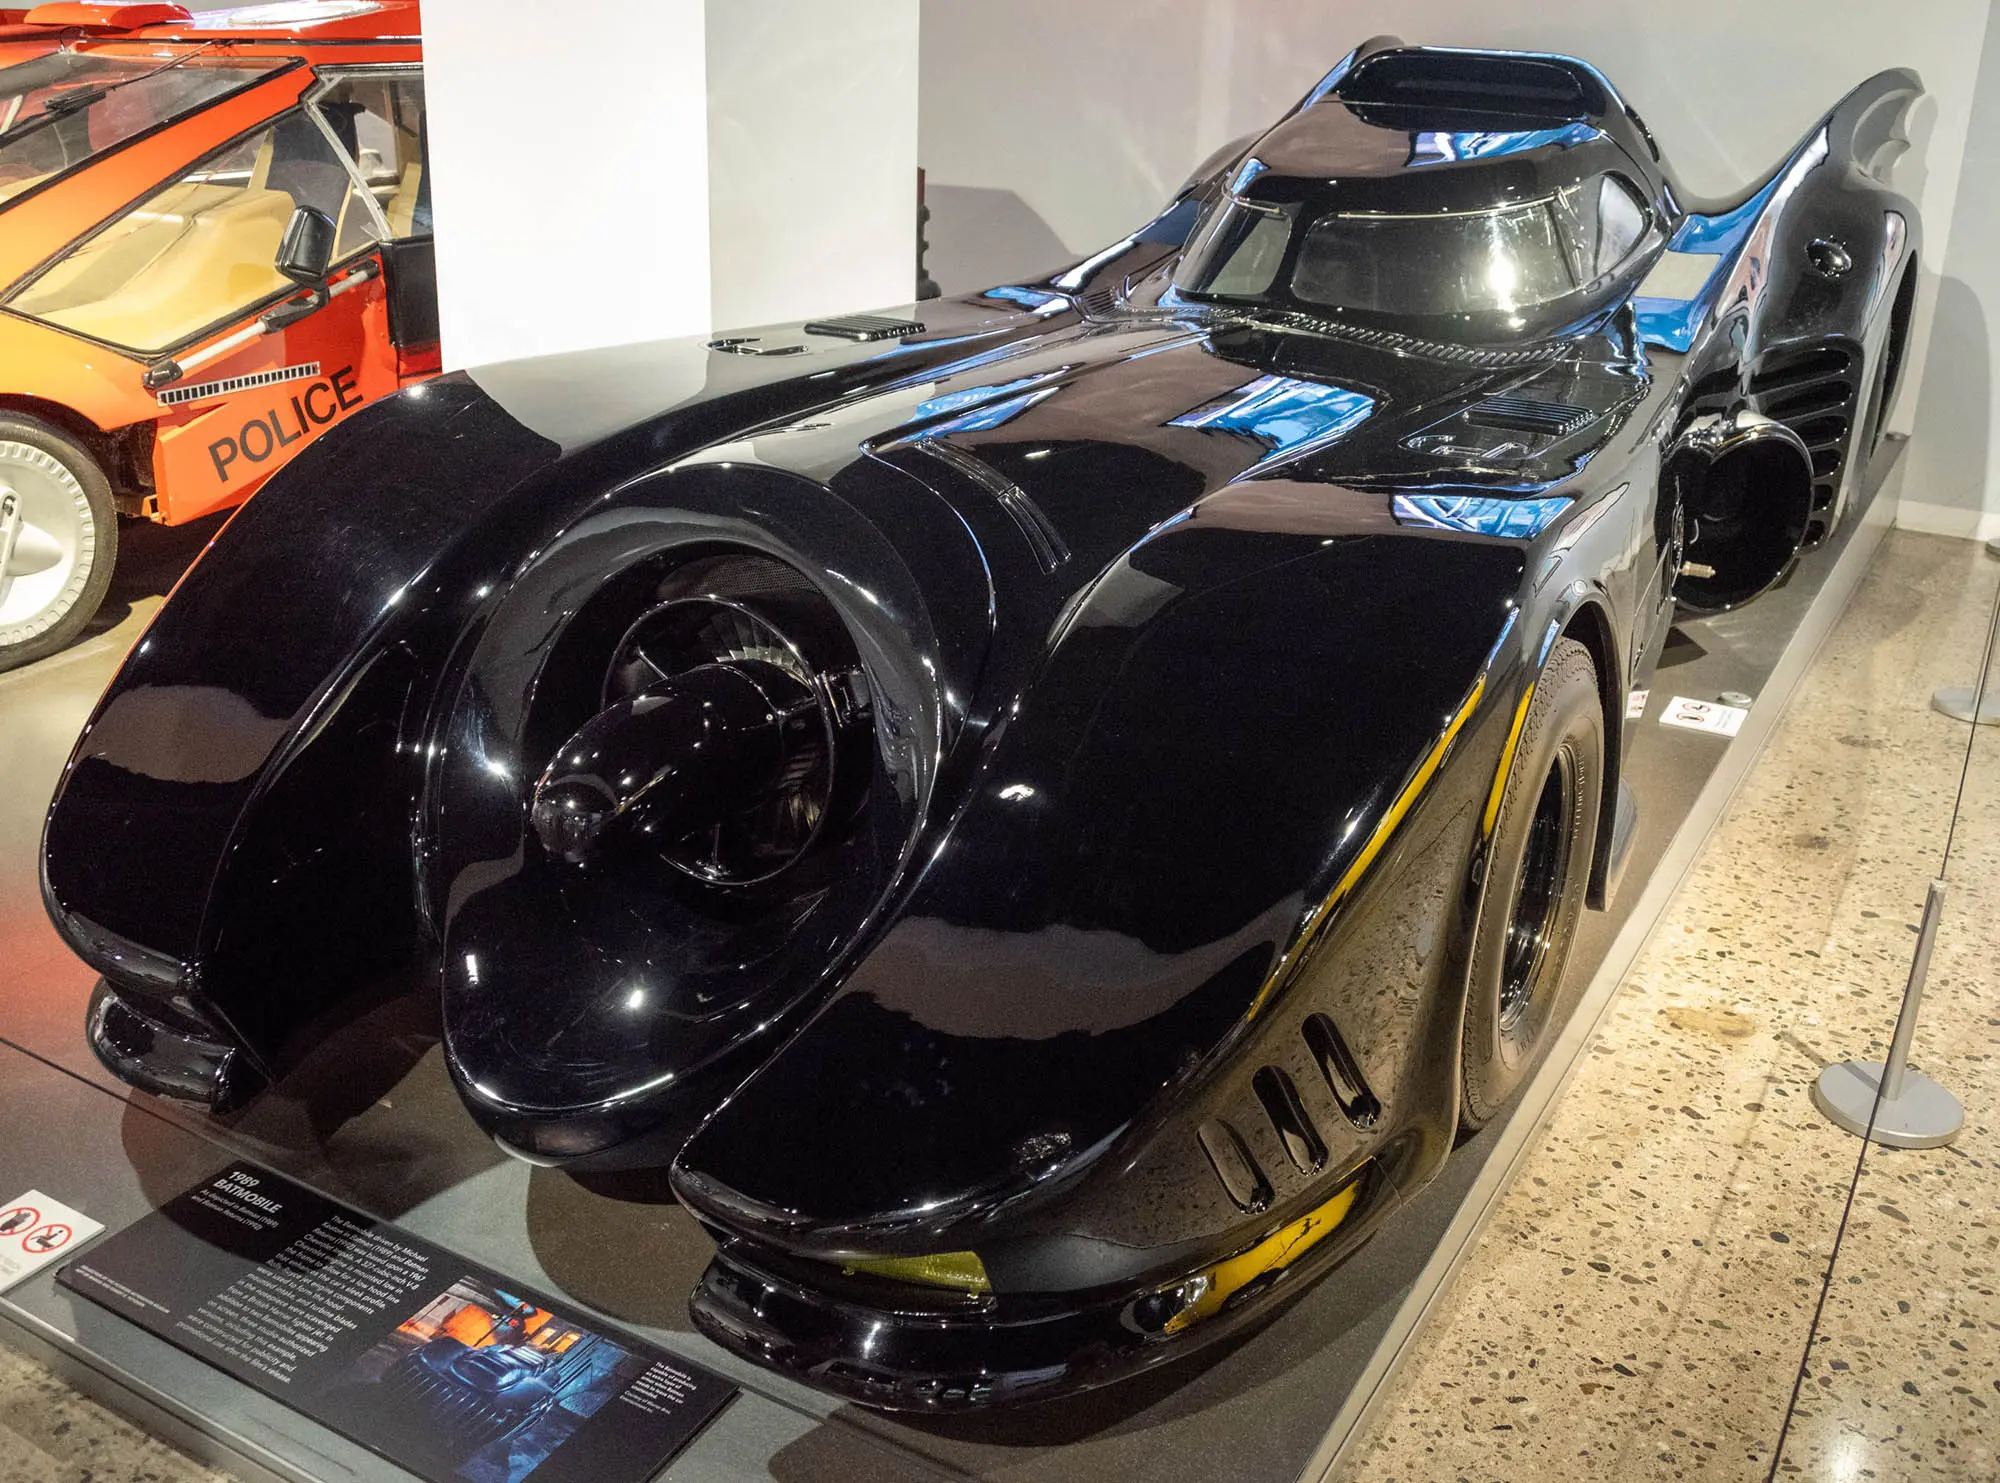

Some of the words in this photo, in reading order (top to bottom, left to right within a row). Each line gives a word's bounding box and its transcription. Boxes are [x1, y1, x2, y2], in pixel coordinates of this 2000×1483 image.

[208, 365, 364, 482] POLICE
[214, 1179, 282, 1213] BATMOBILE
[229, 1172, 259, 1187] 1989
[238, 1207, 260, 1219] Batman
[295, 1240, 326, 1257] Chevrolet
[325, 1256, 347, 1268] engine
[353, 1269, 385, 1285] mounted
[304, 1234, 334, 1250] Chevrolet
[361, 1261, 406, 1284] 327-cubic-inch
[406, 1281, 419, 1290] V-8
[322, 1222, 343, 1234] Keaton
[350, 1236, 373, 1248] Batman
[371, 1245, 393, 1257] (1989)
[404, 1259, 428, 1273] Batman
[334, 1239, 357, 1250] (1992)
[366, 1252, 388, 1264] based
[385, 1263, 403, 1272] upon
[409, 1272, 426, 1281] 1967
[343, 1221, 374, 1238] Batmobile
[373, 1235, 393, 1247] driven
[402, 1248, 428, 1262] Michael
[257, 1267, 273, 1276] were
[272, 1274, 291, 1284] used
[296, 1285, 312, 1296] form
[324, 1298, 345, 1310] hood-
[275, 1253, 290, 1262] that
[345, 1287, 364, 1297] sleek
[296, 1251, 316, 1263] frame
[322, 1265, 341, 1275] allow
[355, 1279, 369, 1288] low
[368, 1286, 389, 1297] hood
[386, 1294, 400, 1304] line
[227, 1285, 243, 1296] from
[248, 1296, 269, 1309] British
[269, 1306, 292, 1320] Harrier
[292, 1318, 315, 1331] fighter
[247, 1273, 278, 1289] mounted
[296, 1298, 312, 1306] and
[310, 1304, 334, 1318] turbine
[334, 1315, 357, 1329] blades
[256, 1289, 288, 1307] nosepiece
[288, 1305, 305, 1315] were
[304, 1314, 342, 1333] scavenged
[311, 1282, 334, 1294] engine
[333, 1293, 374, 1314] components
[188, 1315, 204, 1324] were
[203, 1323, 243, 1344] constructed
[250, 1348, 281, 1365] publicity
[279, 1363, 297, 1372] and
[240, 1316, 258, 1328] three
[255, 1336, 268, 1345] this
[295, 1333, 328, 1352] appearing
